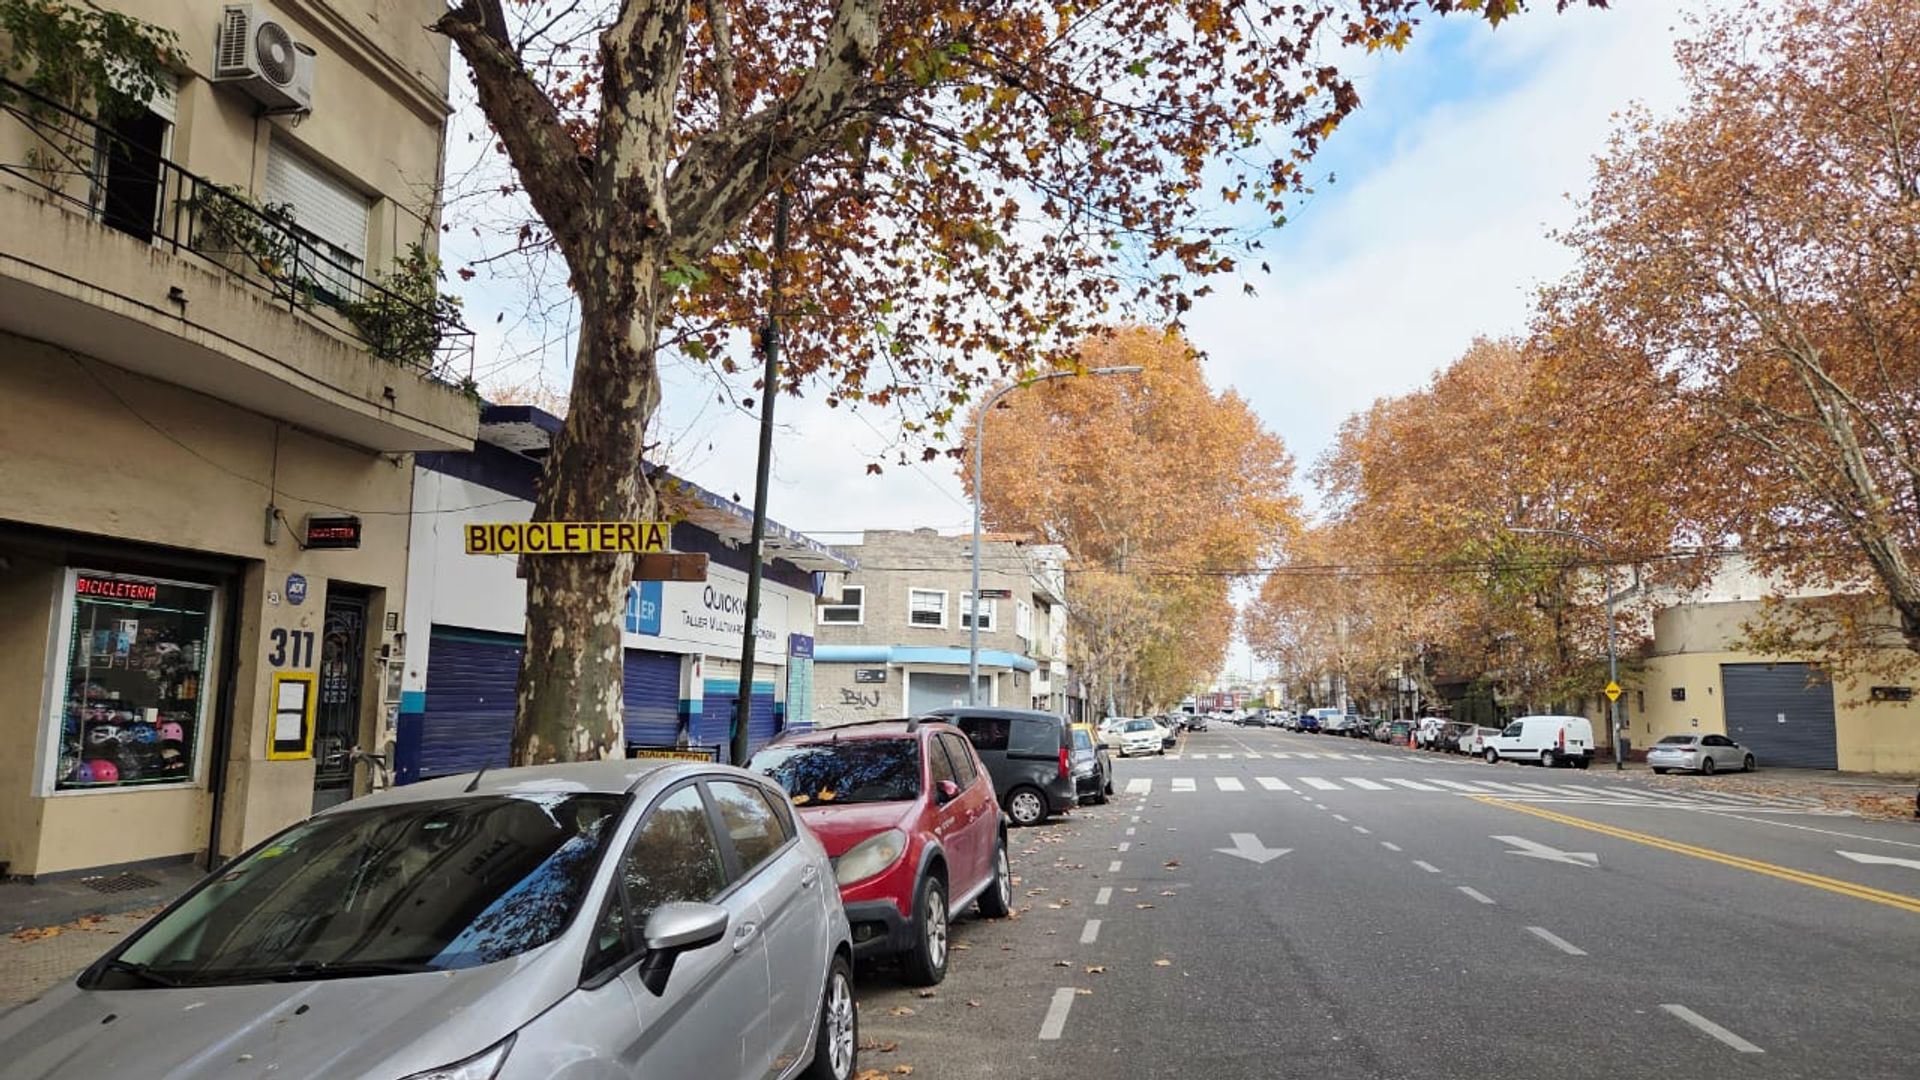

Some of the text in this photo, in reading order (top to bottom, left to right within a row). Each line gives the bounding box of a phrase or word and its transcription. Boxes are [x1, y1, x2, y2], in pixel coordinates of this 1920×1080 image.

[470, 524, 663, 551] BICICLETERIA
[77, 579, 157, 599] BICICLETERIA
[703, 585, 761, 616] QUICKW
[681, 609, 708, 630] TALLER
[709, 615, 745, 636] MULTIMARC
[269, 627, 314, 668] 311
